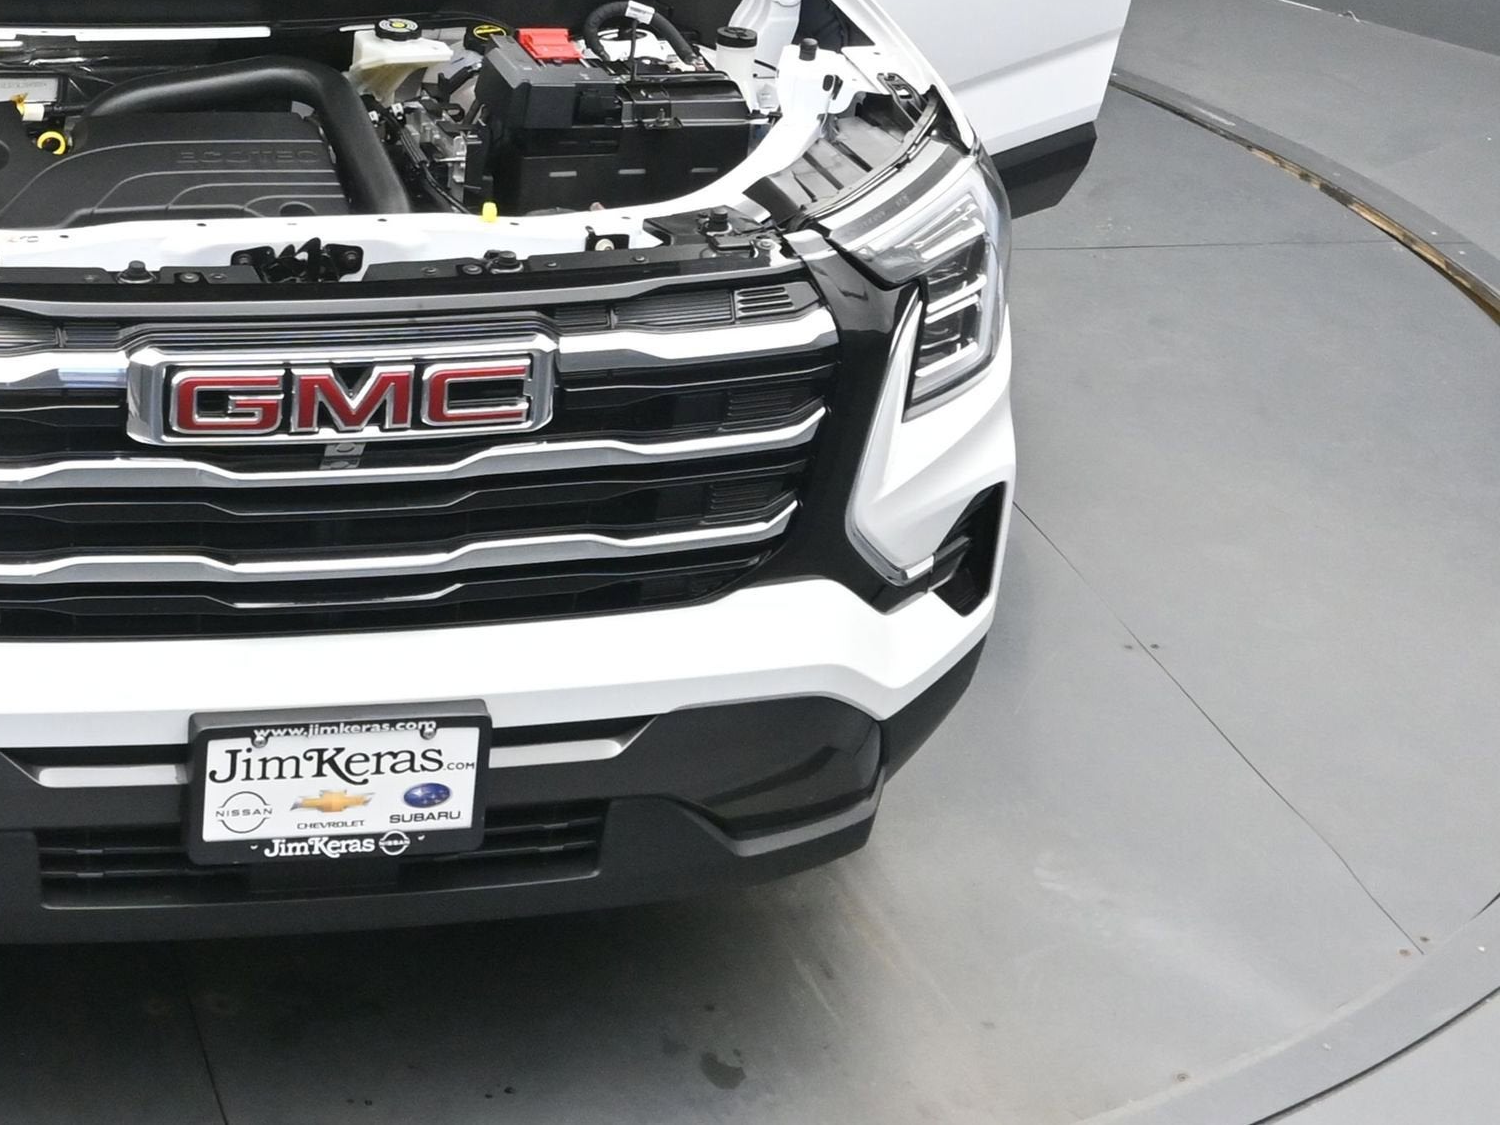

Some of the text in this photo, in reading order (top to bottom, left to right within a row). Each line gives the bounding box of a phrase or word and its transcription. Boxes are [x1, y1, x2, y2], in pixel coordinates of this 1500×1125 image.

[172, 359, 532, 434] GMC
[253, 720, 437, 738] www.jimkeras.com
[215, 807, 273, 818] NISSAN
[389, 810, 461, 824] SUBARU
[296, 819, 365, 830] CHEVROLET
